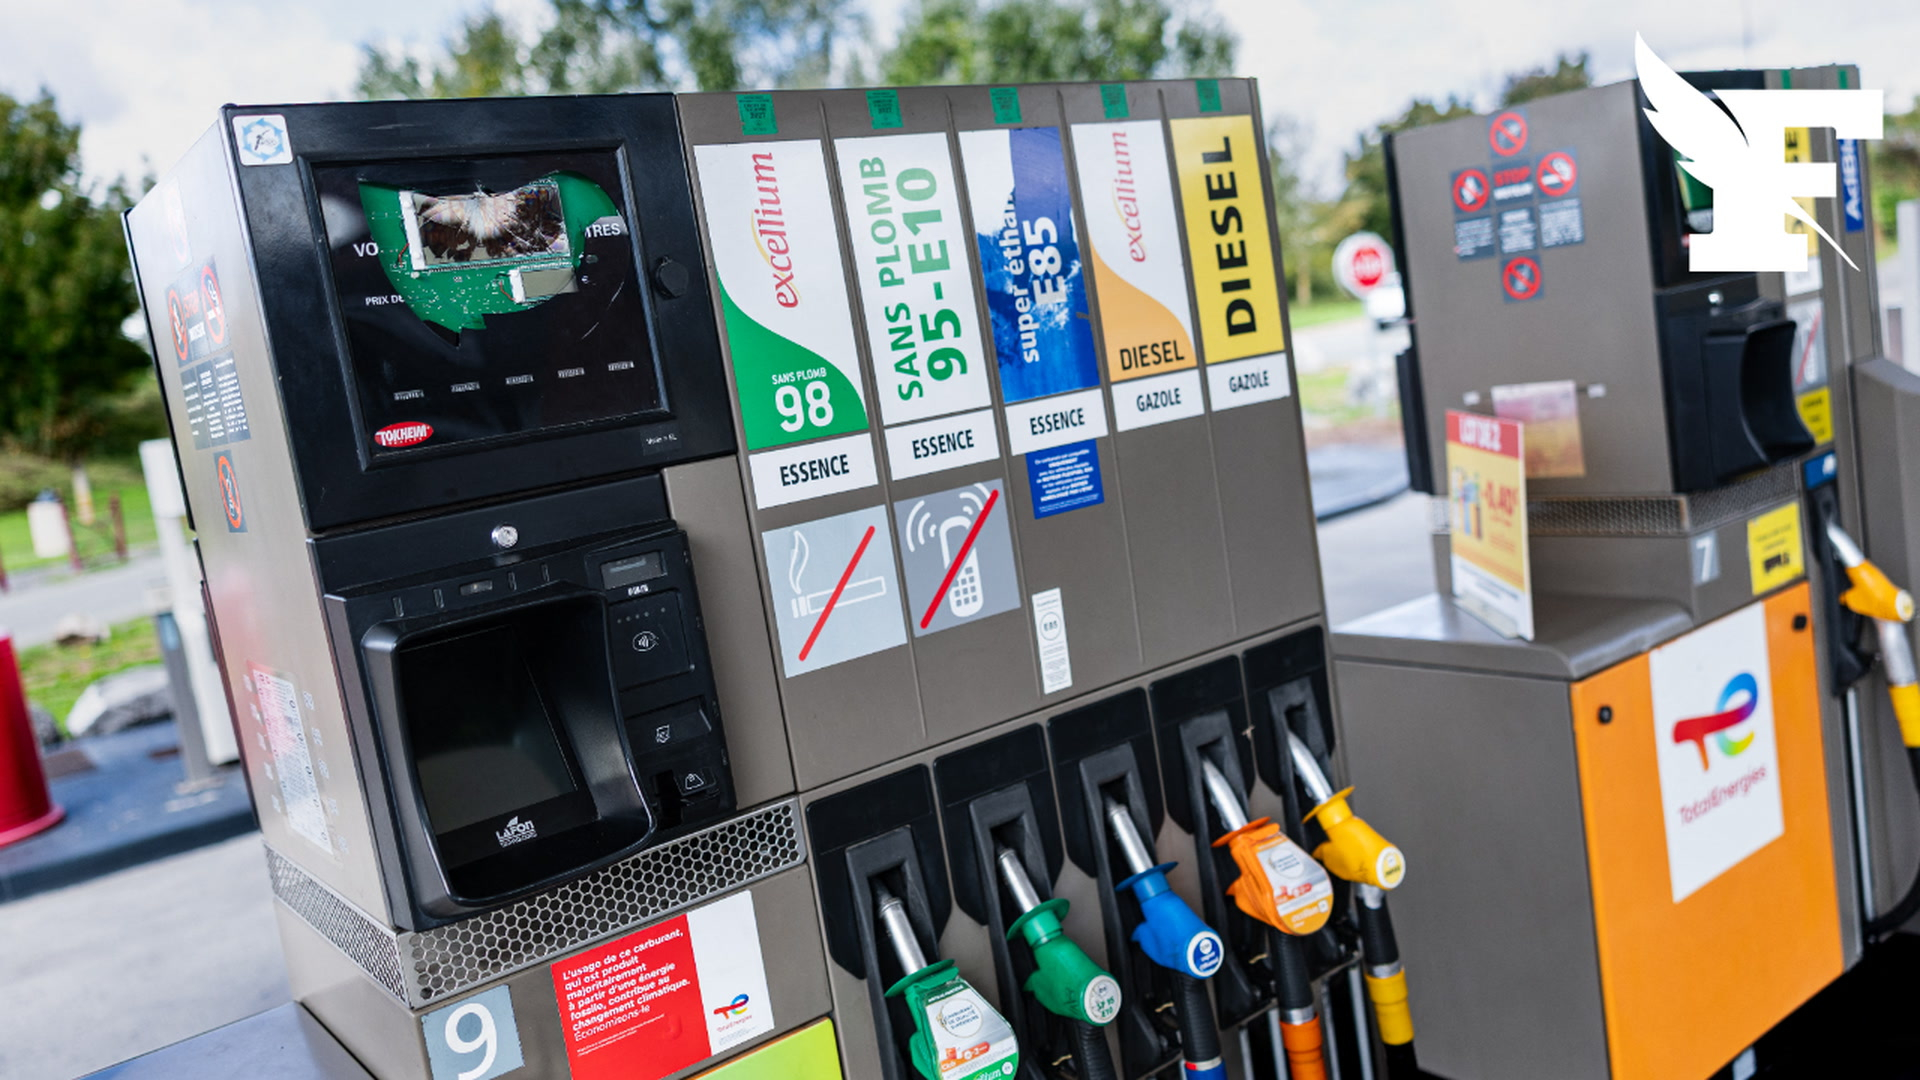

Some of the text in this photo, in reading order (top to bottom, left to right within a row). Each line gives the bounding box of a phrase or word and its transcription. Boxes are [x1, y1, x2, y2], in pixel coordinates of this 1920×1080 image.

[1112, 131, 1146, 263] excellium
[752, 152, 799, 309] excellium
[859, 156, 904, 288] PLOMB
[1201, 136, 1258, 336] DIESEL
[896, 167, 968, 382] 95-E10
[1022, 216, 1068, 307] E85
[365, 296, 389, 306] PRIX
[1014, 285, 1040, 364] super
[772, 366, 827, 385] SANS PLOMB
[884, 302, 924, 401] SANS
[1119, 340, 1184, 371] DIESEL
[1136, 388, 1182, 412] GAZOLE
[1229, 370, 1270, 393] GAZOLE
[774, 381, 834, 432] 98
[1030, 408, 1086, 436] ESSENCE
[376, 424, 426, 446] TOKHEIM
[912, 430, 974, 460] ESSENCE
[780, 454, 850, 487] ESSENCE
[1696, 536, 1714, 582] 7
[1680, 765, 1767, 824] TotalEnergies
[604, 954, 616, 965] de
[619, 950, 631, 959] ce
[633, 928, 684, 954] carburant,
[564, 956, 639, 991] qui est produit
[566, 964, 647, 1001] majoritairement
[568, 1001, 576, 1012] à
[578, 990, 606, 1012] partir
[639, 962, 676, 983] énergie
[570, 974, 670, 1022] fossile, contribue au
[572, 979, 691, 1032] changement climatique.
[445, 1003, 497, 1080] 9
